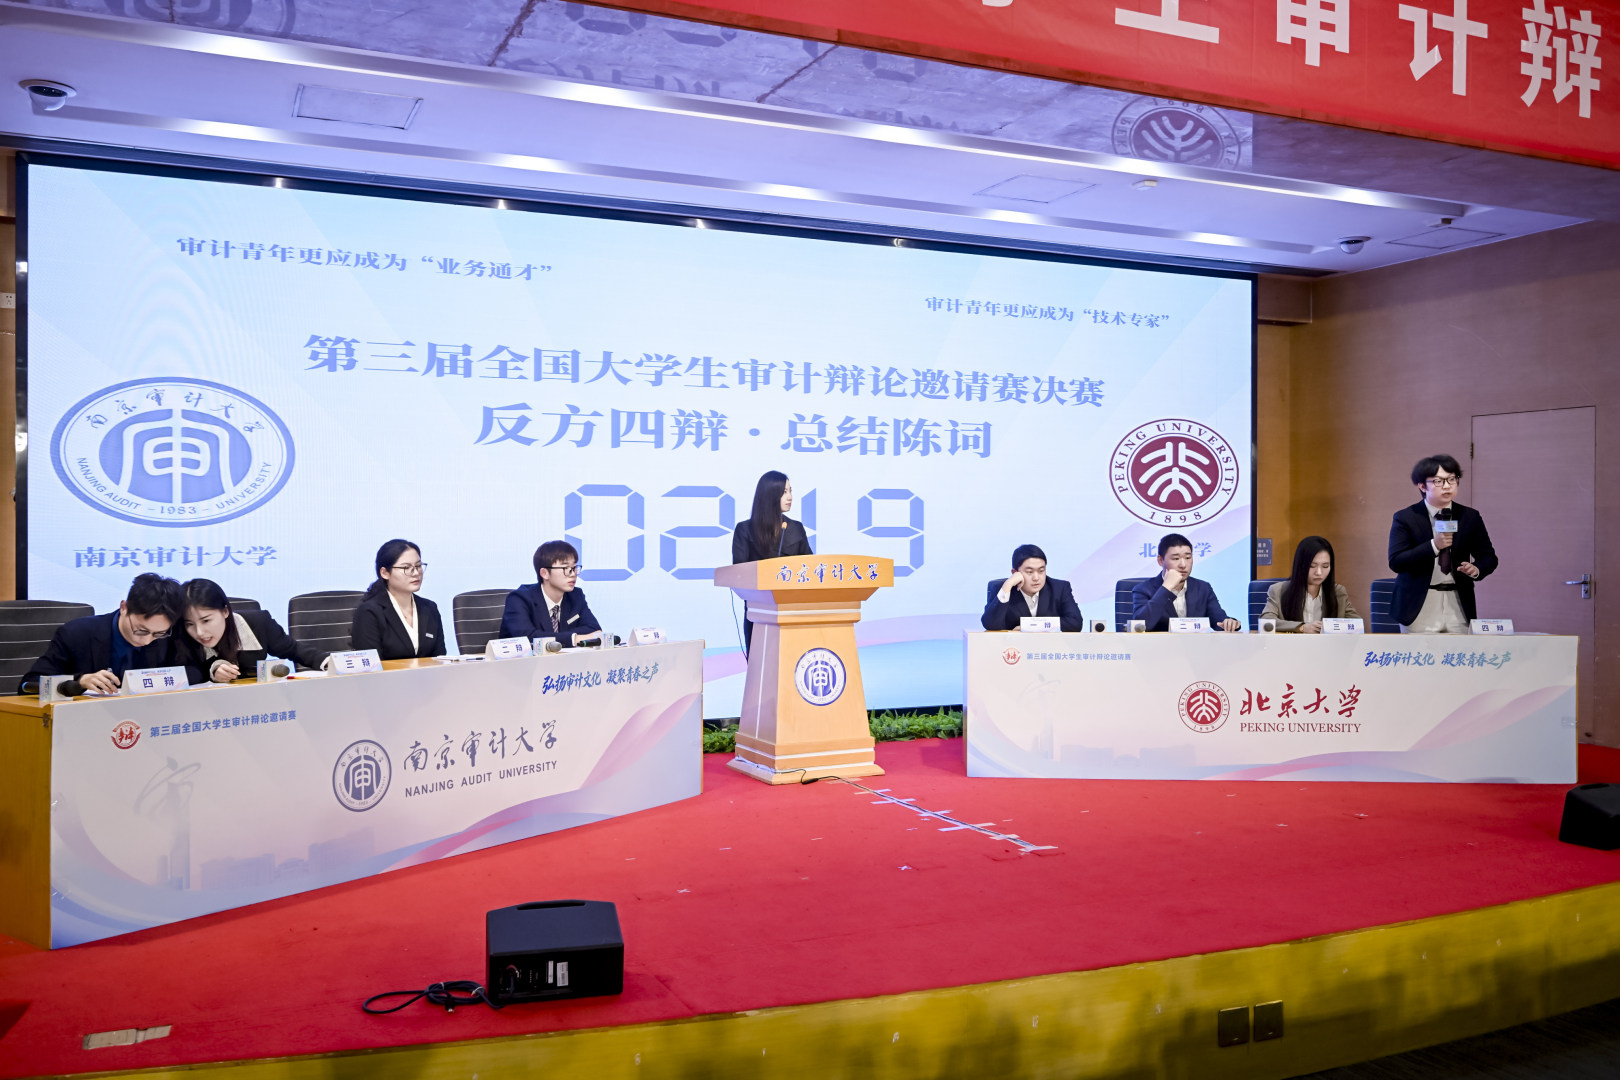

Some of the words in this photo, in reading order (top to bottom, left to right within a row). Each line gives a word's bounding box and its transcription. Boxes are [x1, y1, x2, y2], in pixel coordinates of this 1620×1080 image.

[982, 0, 1602, 118] 审计辩
[303, 334, 1106, 408] 第三届全国大学生审计辩论邀请赛决赛
[1114, 430, 1148, 494] PEKING
[1156, 422, 1235, 496] UNIVERSITY
[76, 456, 106, 493] NANJING
[105, 492, 142, 511] AUDIT
[215, 461, 272, 510] UNIVERSITY
[1149, 510, 1203, 524] 1898
[72, 545, 278, 568] 南京审计大学
[1138, 542, 1212, 558] 北学
[776, 563, 879, 583] 南京审计大学
[1364, 651, 1436, 669] 弘扬审计文化
[542, 670, 602, 695] 弘扬审计文化
[1239, 683, 1362, 718] 北京大学
[150, 710, 297, 738] 第三届全国大学生审计辩论邀请赛
[1240, 722, 1285, 733] PEKING
[1288, 722, 1362, 733] UNIVERSITY
[403, 719, 558, 773] 南京审计大学
[405, 779, 454, 798] NANJING
[461, 772, 492, 787] AUDIT
[499, 760, 557, 779] UNIVERSITY
